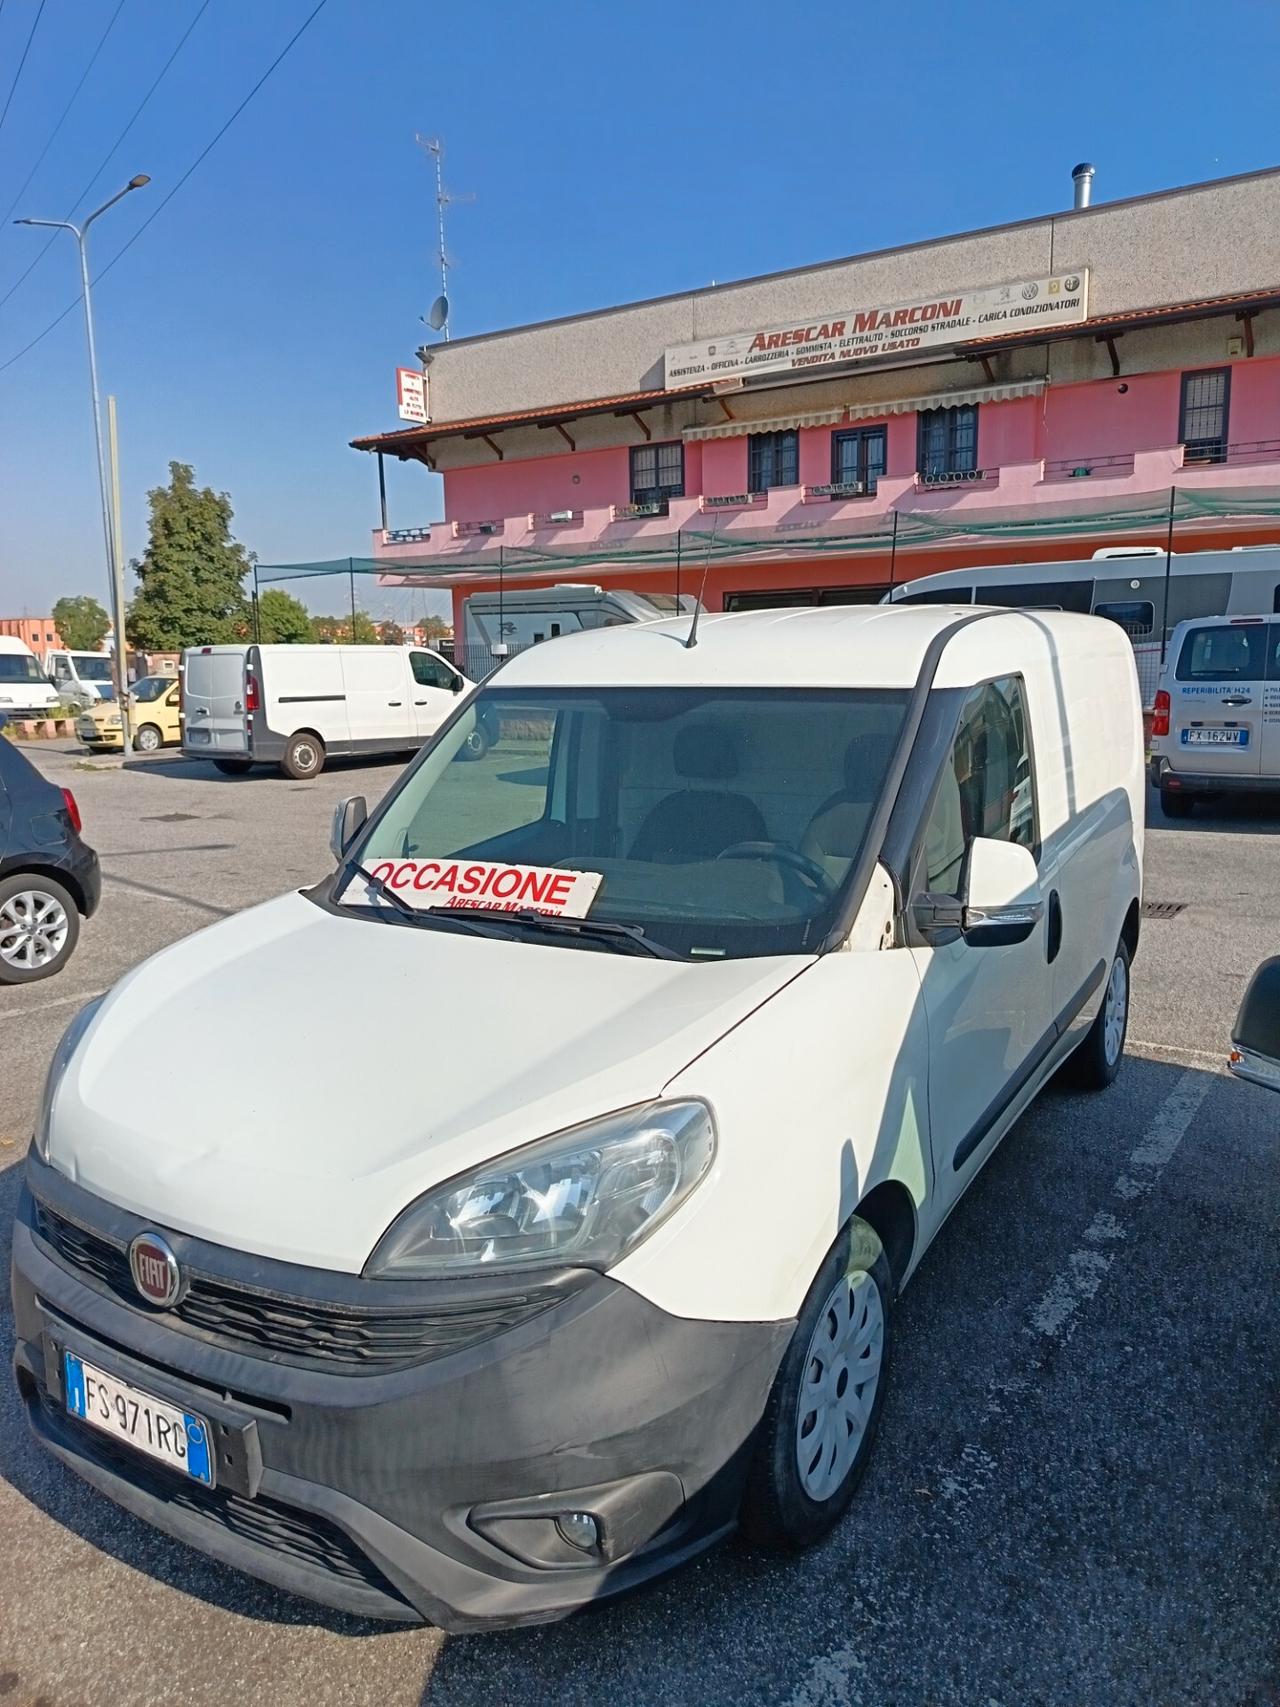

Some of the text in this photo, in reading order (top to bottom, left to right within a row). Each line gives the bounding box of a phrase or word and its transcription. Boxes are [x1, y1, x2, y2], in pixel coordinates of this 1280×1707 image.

[669, 364, 705, 377] ASSISTENZA
[711, 358, 738, 371] OFFICINA
[744, 350, 789, 365] CARROZZERIA
[796, 342, 832, 355] GOMMISTA
[839, 332, 884, 348] ELETTRAUTO
[890, 324, 929, 339] SOCCORSO
[930, 317, 971, 332] STRADALE
[978, 310, 1008, 324] CARICA
[1009, 298, 1080, 318] CONDIZIONATORI
[747, 298, 963, 353] ARESCAR MARCONI
[790, 337, 921, 368] VENDITA NUOVO USATO
[371, 862, 577, 905] OCCASIONE
[138, 1253, 166, 1290] FIAT
